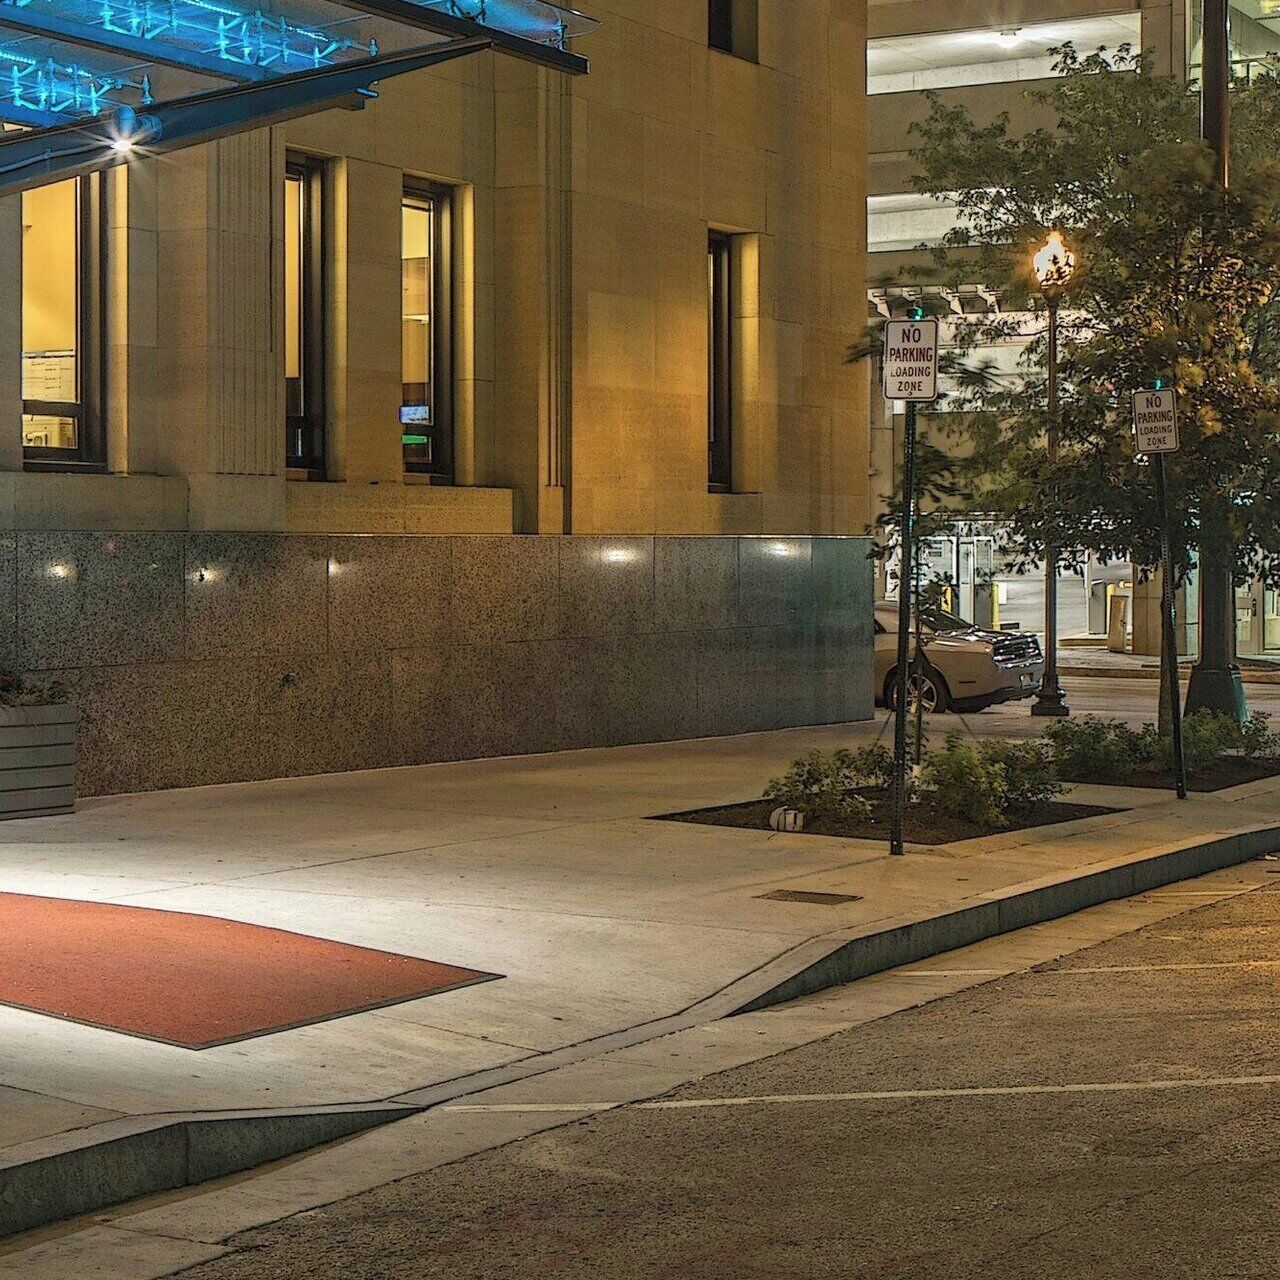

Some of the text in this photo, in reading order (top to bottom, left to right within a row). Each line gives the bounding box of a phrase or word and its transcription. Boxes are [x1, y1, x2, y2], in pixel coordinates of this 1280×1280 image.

[901, 328, 921, 343] NO
[889, 347, 933, 362] PARKING
[890, 366, 931, 377] LOADING
[897, 381, 923, 392] ZONE
[1146, 396, 1162, 408] NO
[1137, 410, 1173, 424] PARKING
[1140, 425, 1173, 436] LOADING
[1147, 437, 1167, 446] ZONE
